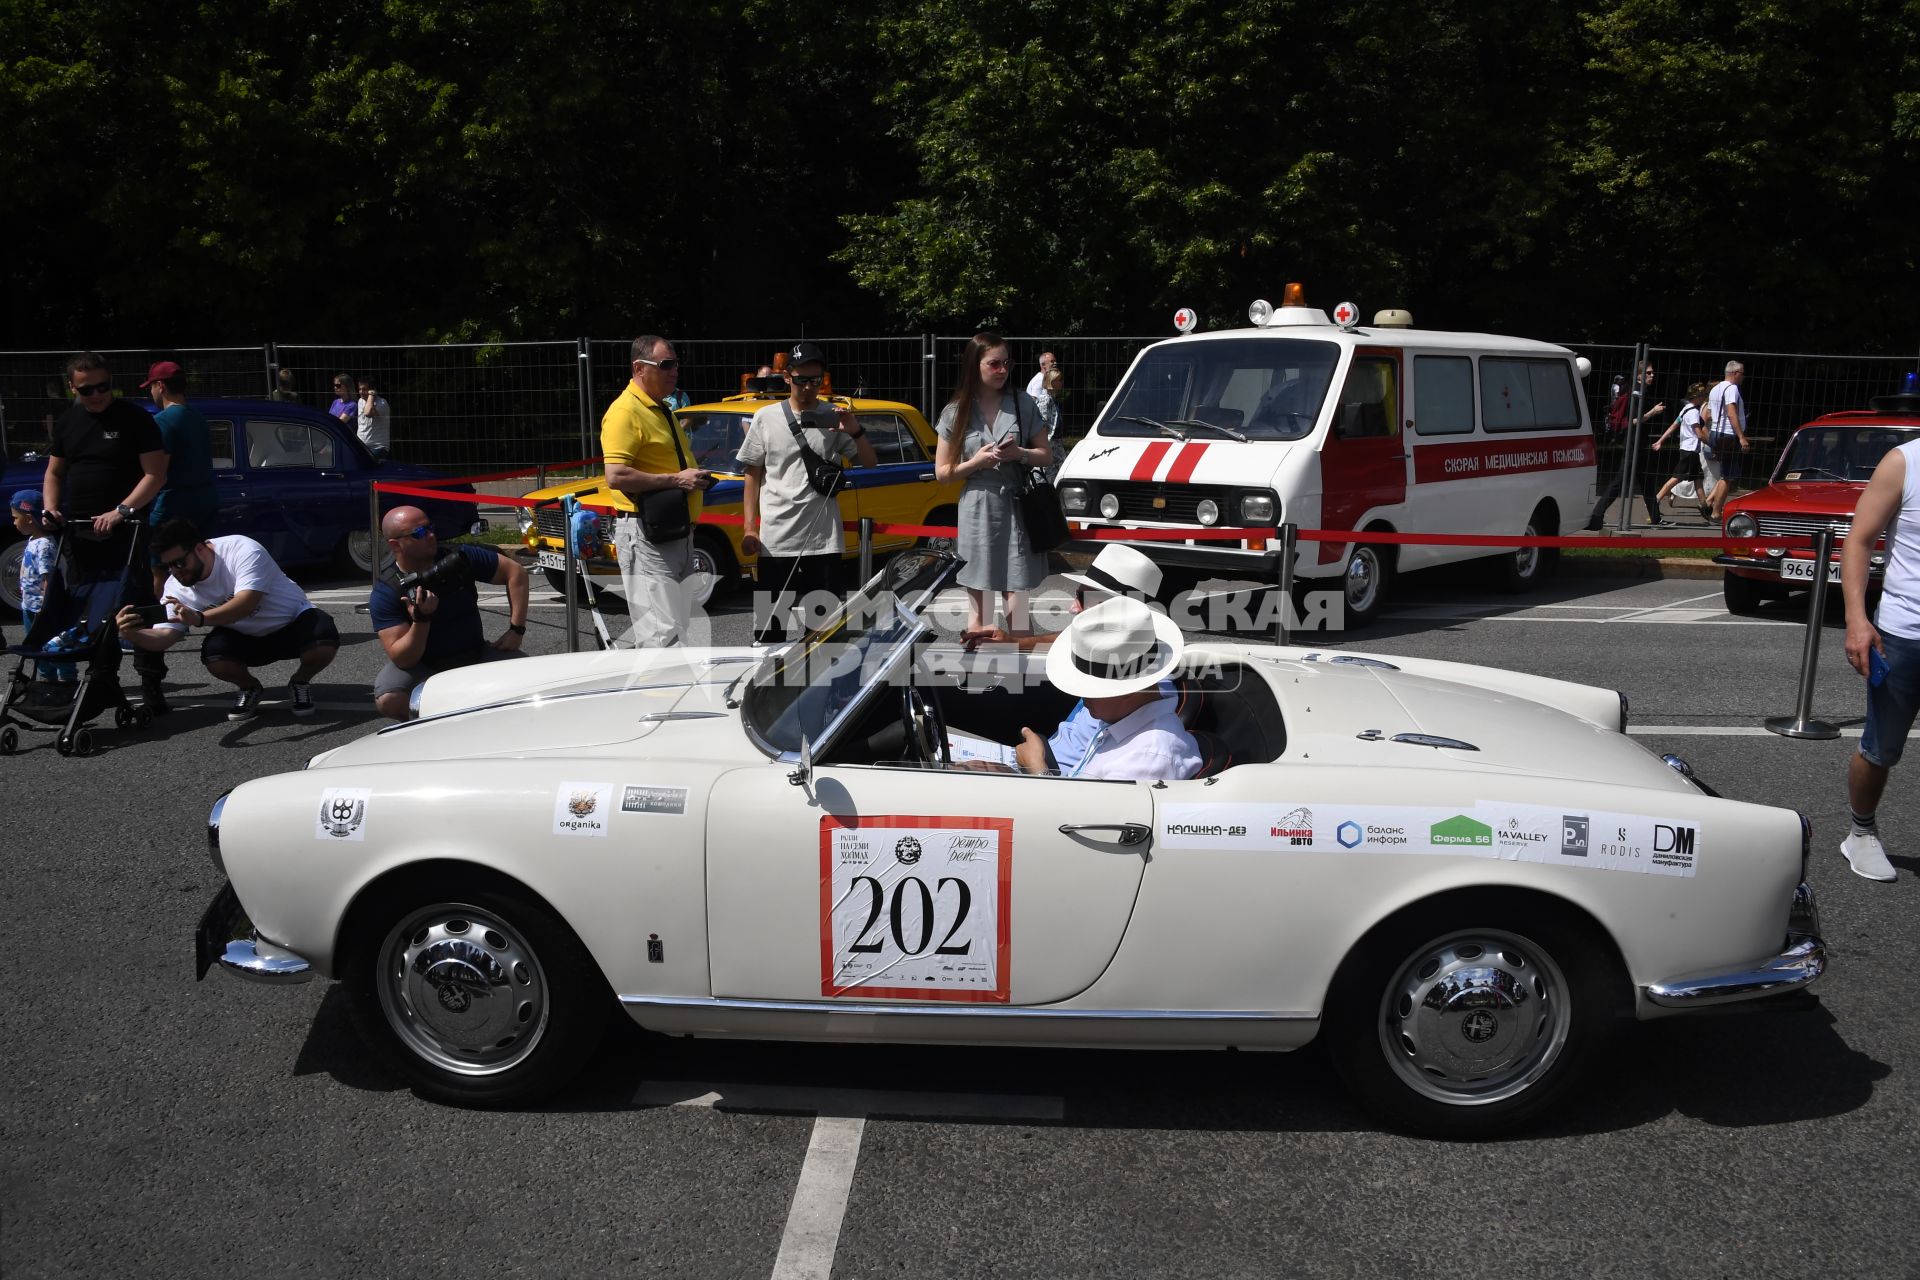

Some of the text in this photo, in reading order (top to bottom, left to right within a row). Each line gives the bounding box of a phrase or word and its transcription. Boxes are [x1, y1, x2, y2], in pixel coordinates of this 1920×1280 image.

[1444, 448, 1585, 473] СКОРАЯ МЕДИЦИНСКАЯ ПОМОЩЬ
[1270, 826, 1313, 838] Ильинка
[1367, 825, 1404, 835] баланс
[1290, 837, 1313, 846] авто
[1367, 836, 1407, 844] информ
[1432, 834, 1490, 844] Ферма 56
[1510, 831, 1548, 842] VALLEY
[1653, 824, 1694, 854] DM
[1600, 843, 1640, 858] RODIS
[1652, 852, 1693, 861] даниловская
[1652, 859, 1692, 868] мануфактура
[848, 876, 972, 955] 202
